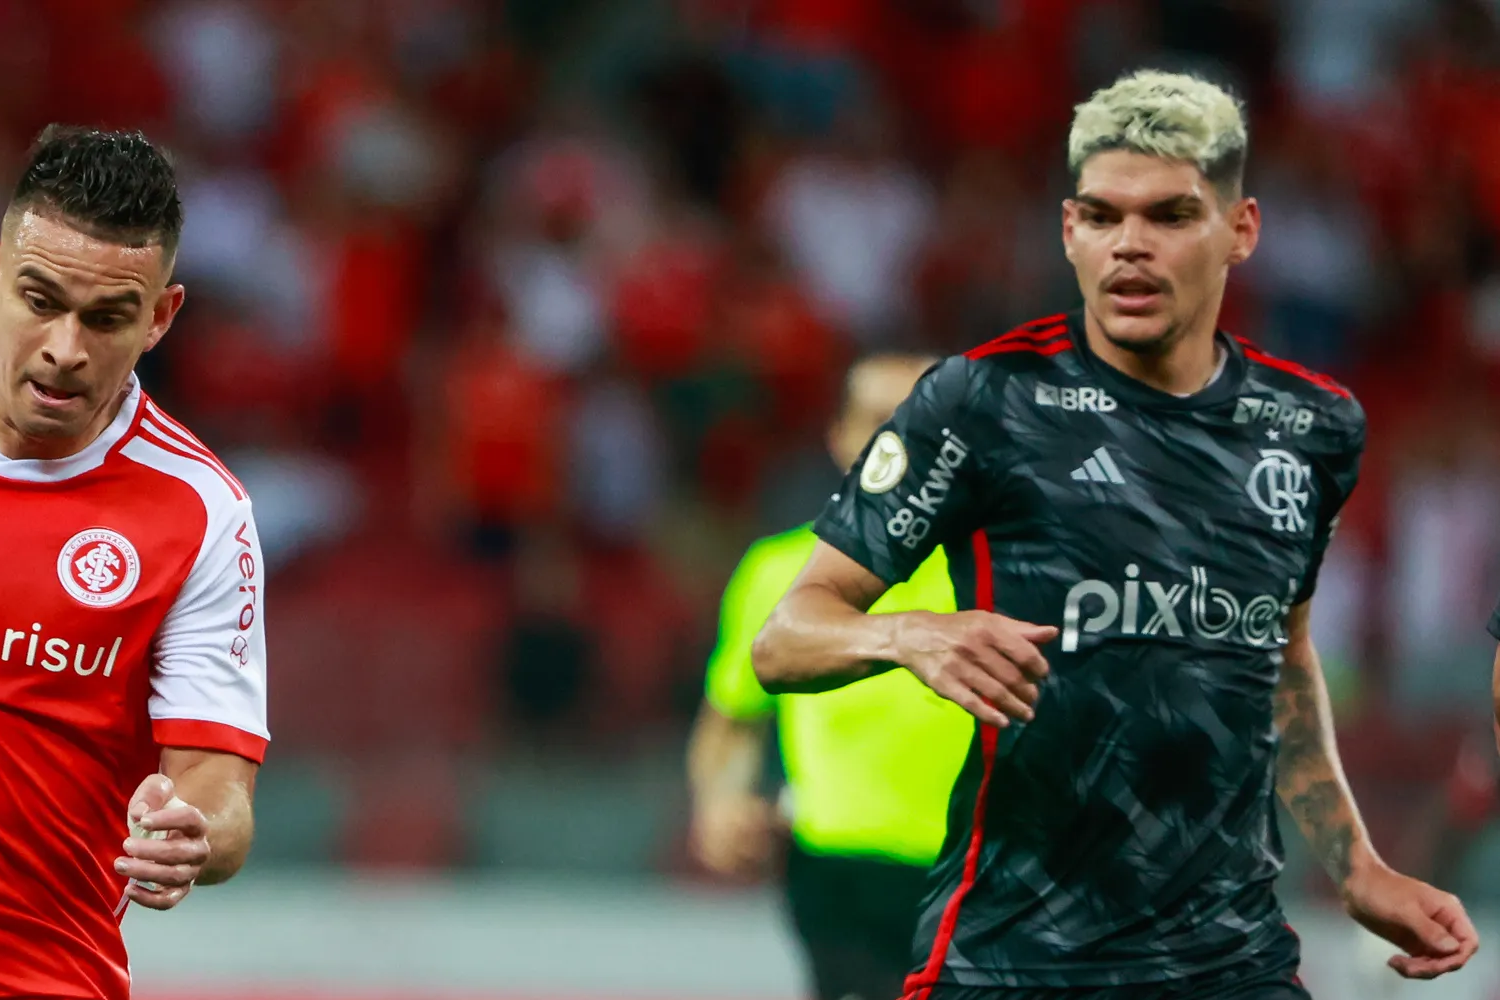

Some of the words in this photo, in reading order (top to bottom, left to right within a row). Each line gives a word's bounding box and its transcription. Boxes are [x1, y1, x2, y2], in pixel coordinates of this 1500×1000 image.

[1261, 402, 1314, 435] BRB
[907, 428, 969, 515] kwai
[235, 521, 256, 631] vero
